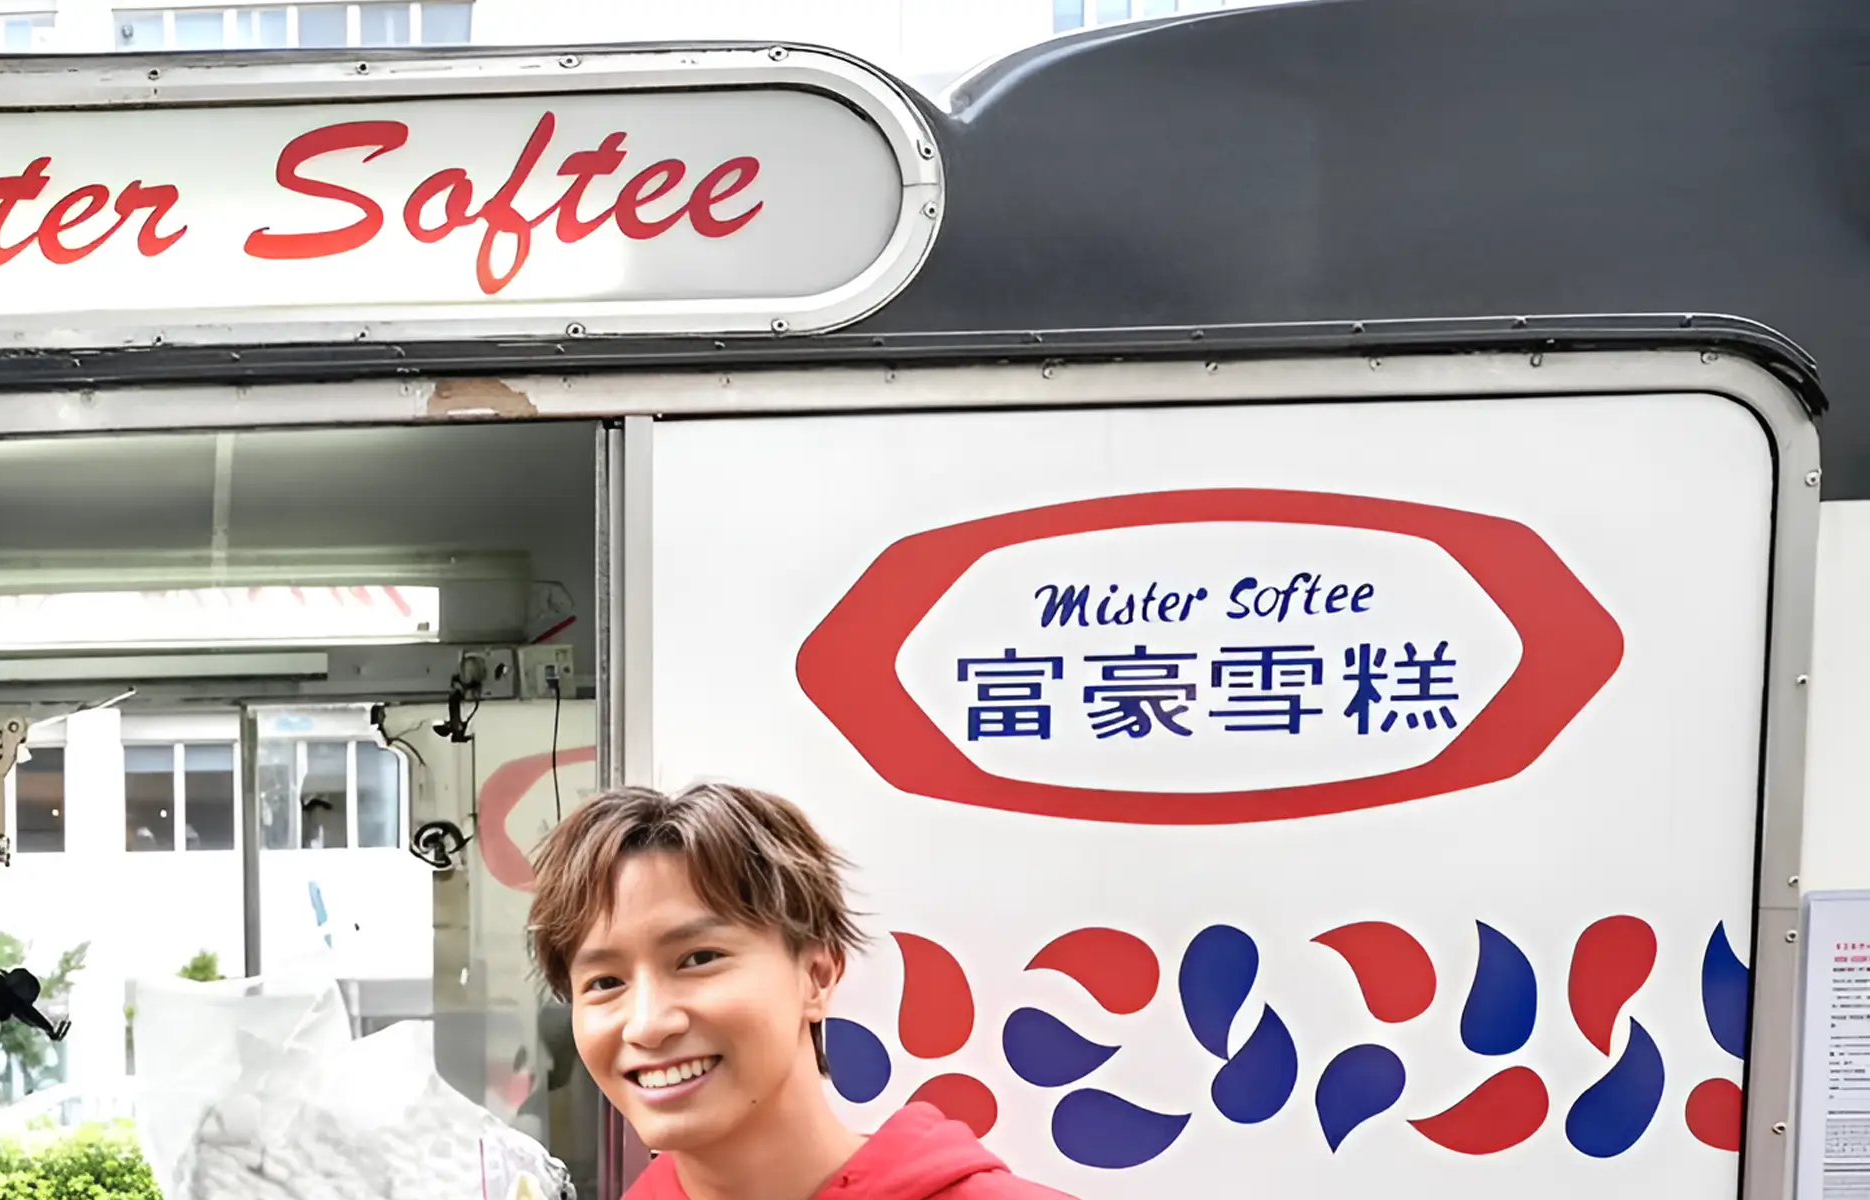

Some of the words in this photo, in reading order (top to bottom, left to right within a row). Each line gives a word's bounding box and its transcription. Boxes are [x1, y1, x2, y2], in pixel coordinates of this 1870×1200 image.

[243, 111, 763, 295] Softee
[1034, 583, 1208, 629] Mister
[1226, 572, 1375, 622] Softee
[956, 641, 1460, 742] 富豪雪糕
